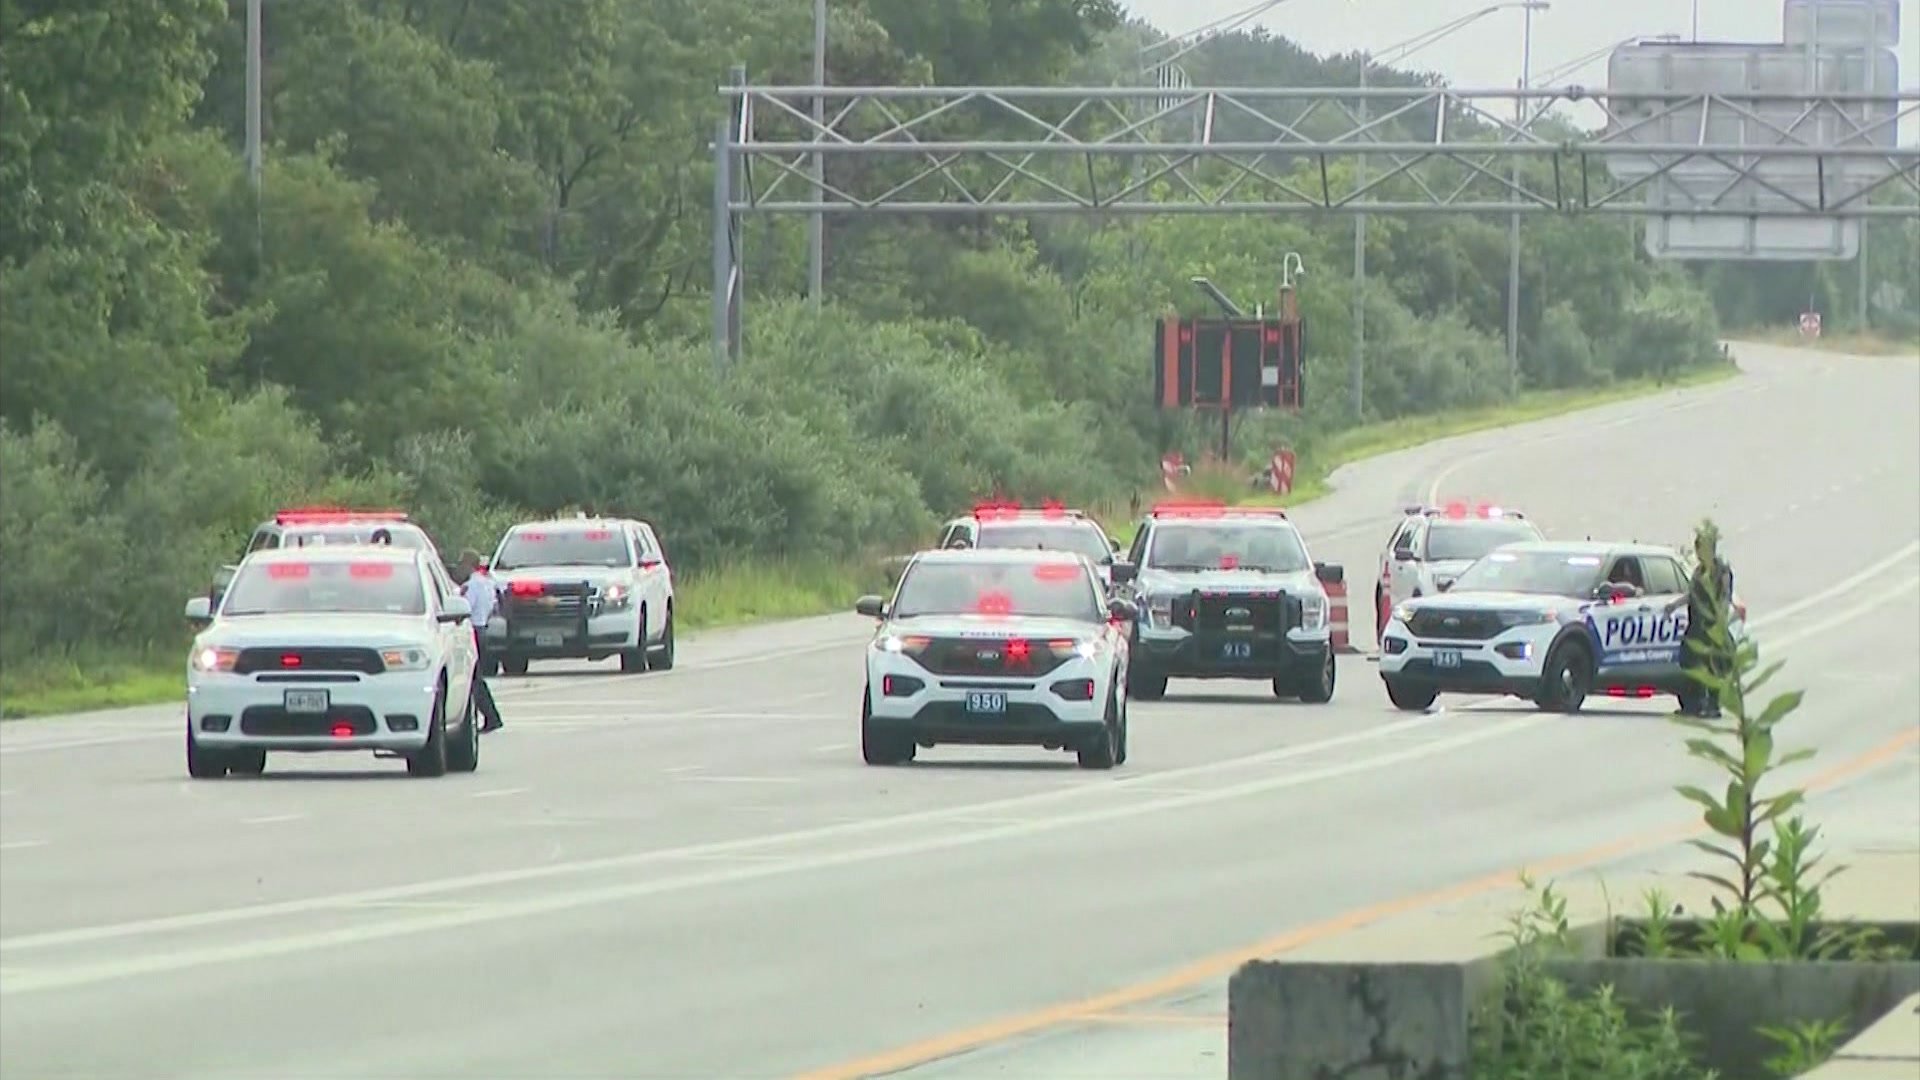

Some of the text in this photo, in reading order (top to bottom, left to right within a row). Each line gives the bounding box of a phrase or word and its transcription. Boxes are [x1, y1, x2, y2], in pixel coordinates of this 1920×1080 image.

[1606, 615, 1685, 647] POLICE
[1223, 643, 1251, 657] 913
[971, 693, 1002, 710] 950
